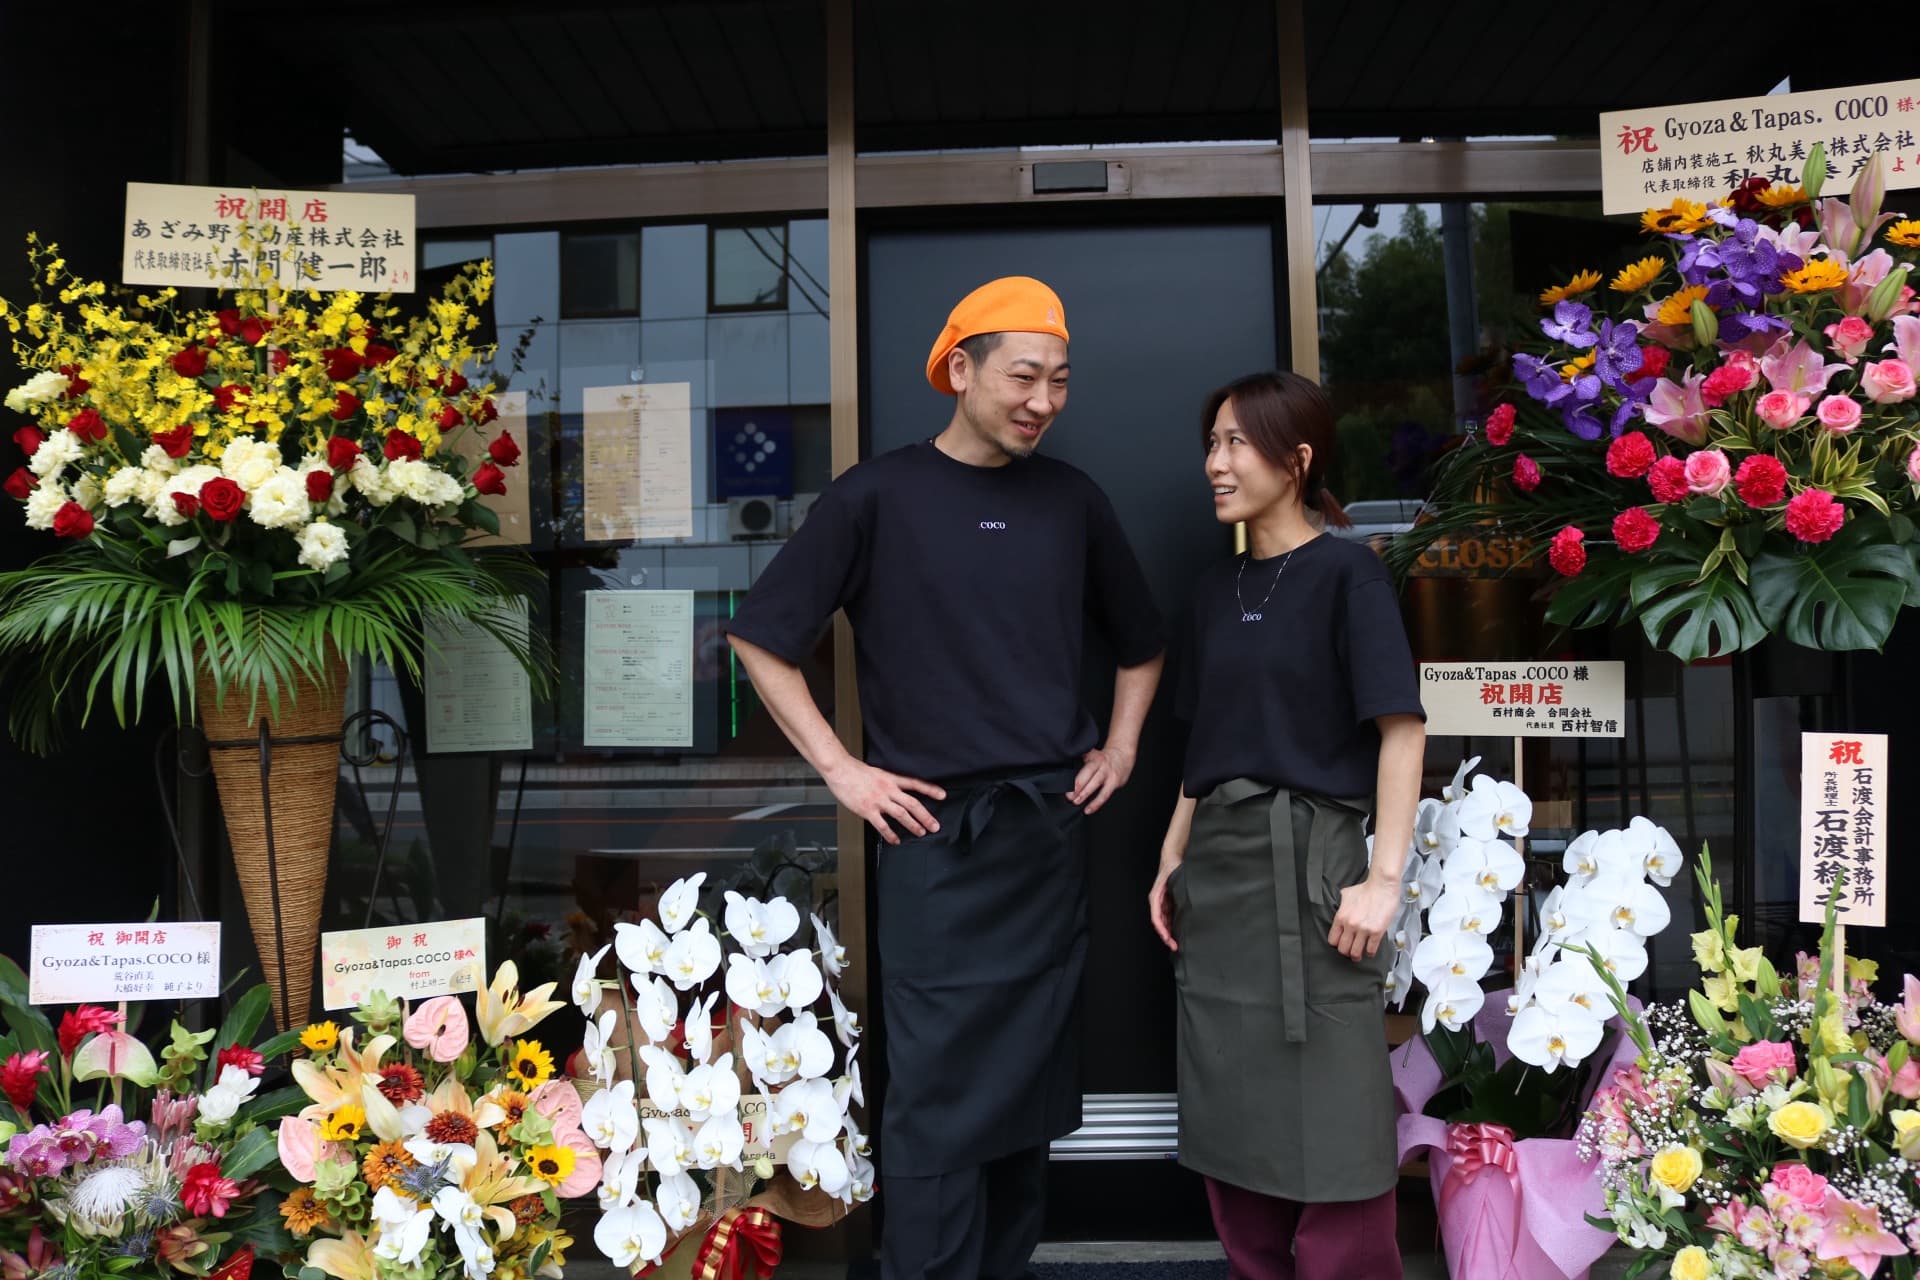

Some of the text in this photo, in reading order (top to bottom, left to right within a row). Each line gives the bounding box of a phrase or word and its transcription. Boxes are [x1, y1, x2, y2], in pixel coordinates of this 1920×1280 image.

[1835, 96, 1888, 121] COCO
[1617, 125, 1659, 155] 祝
[1641, 129, 1915, 173] 店舗内装施工 秋丸美株式会社
[1644, 177, 1717, 193] 代表取締役
[214, 194, 328, 223] 祝開店
[1424, 667, 1517, 682] Gyoza&Tapas
[1573, 665, 1589, 681] 様
[1479, 682, 1564, 705] 祝開店
[1492, 707, 1592, 718] 西村商会 合同会社
[1561, 719, 1618, 733] 西村智信
[1829, 740, 1864, 765] 祝
[1852, 767, 1875, 906] 石渡会計事務所
[88, 930, 167, 946] 祝 御開店
[42, 951, 211, 971] Gyoza&Tapas.COCO 様
[334, 952, 451, 975] Gyoza&Tapas.COCO
[409, 970, 430, 979] from
